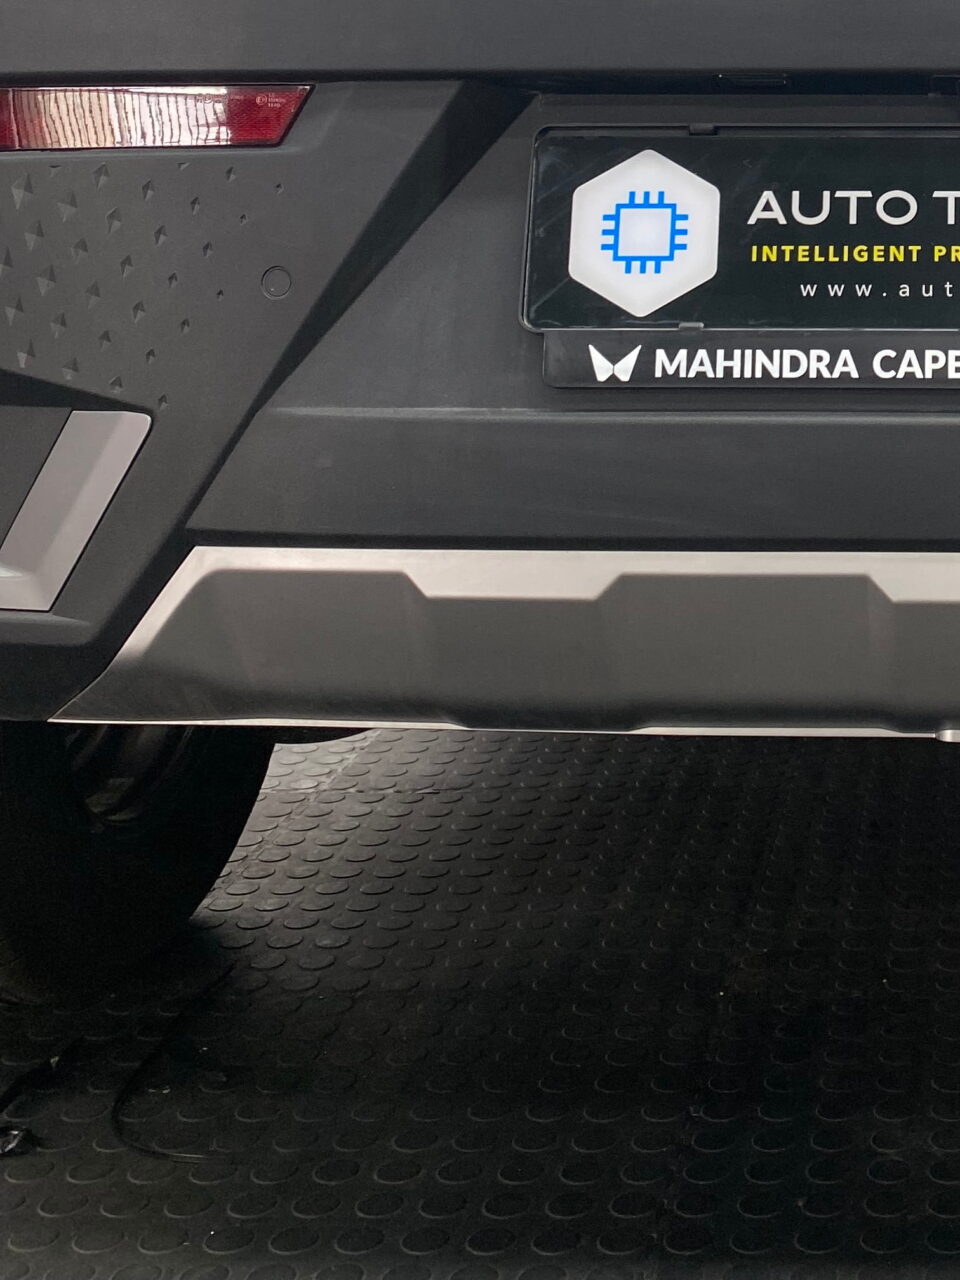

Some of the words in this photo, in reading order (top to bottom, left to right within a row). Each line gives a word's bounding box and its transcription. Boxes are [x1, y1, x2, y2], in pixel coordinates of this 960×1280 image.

[746, 189, 918, 226] AUTO
[750, 244, 922, 264] INTELLIGENT
[654, 348, 860, 379] MAHINDRA
